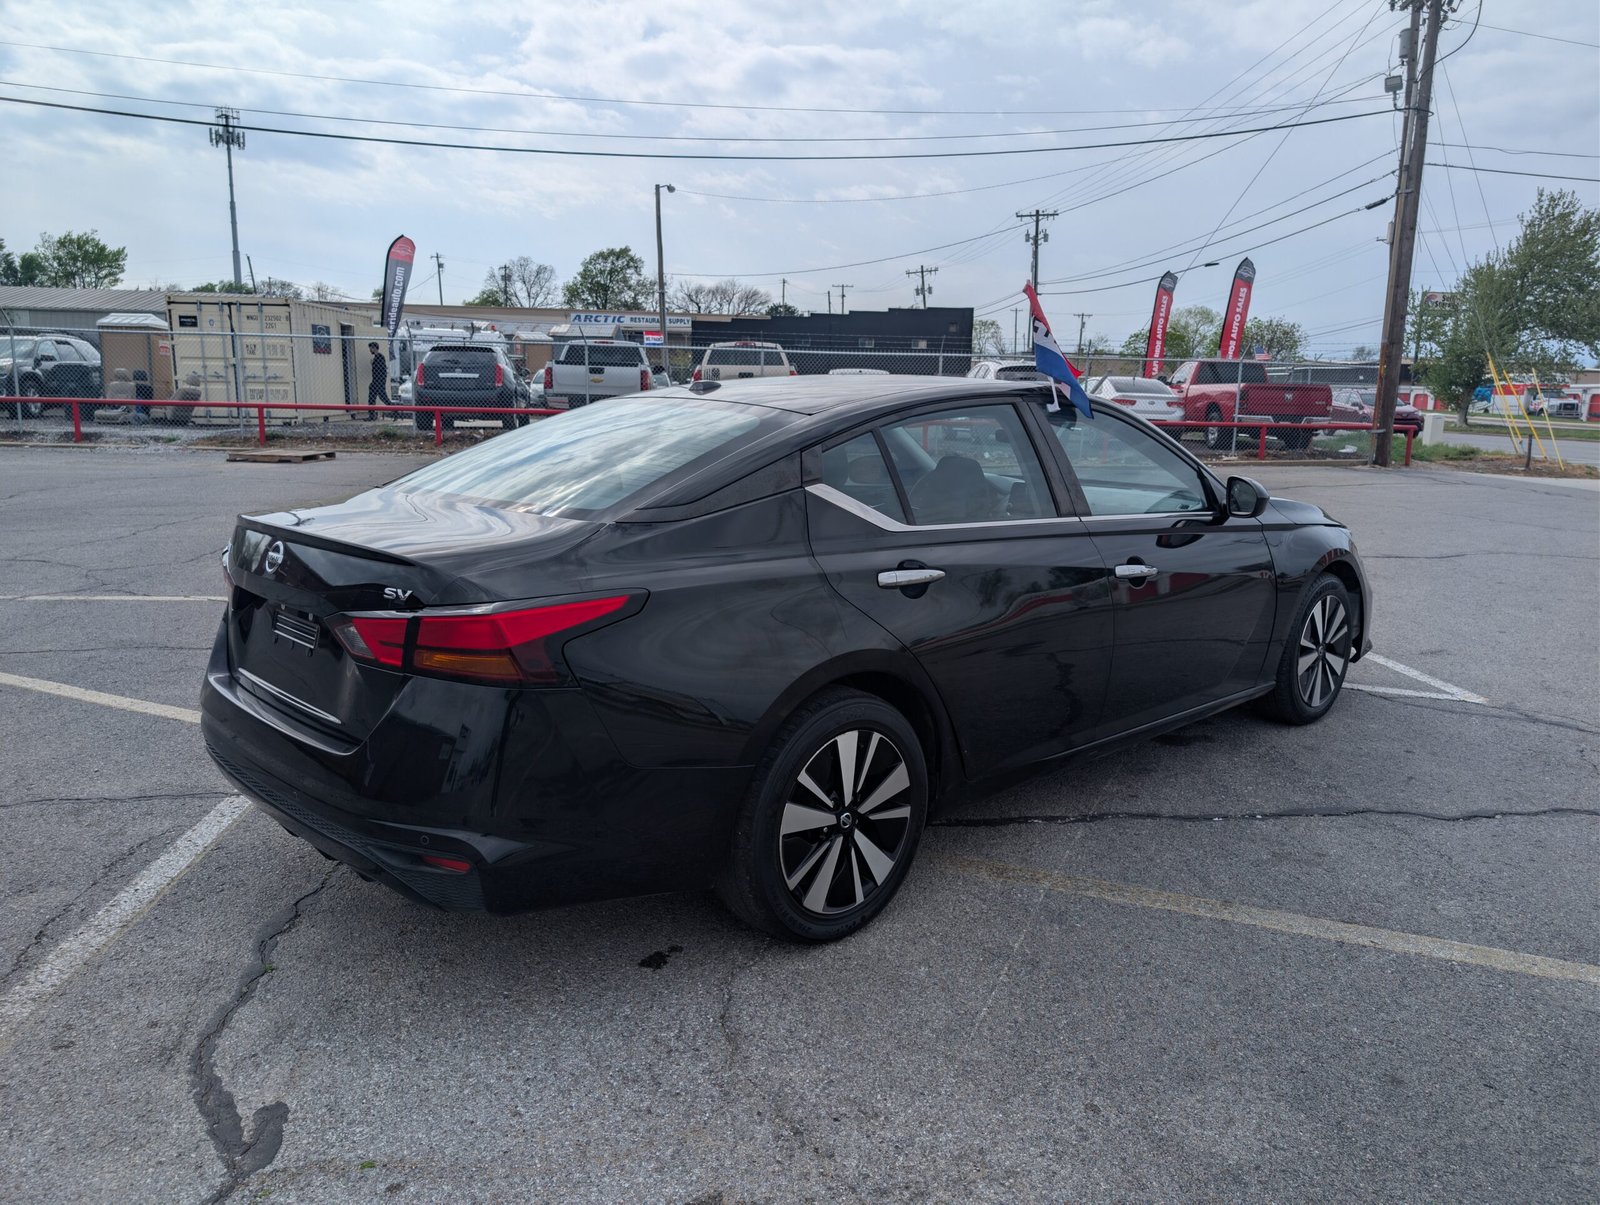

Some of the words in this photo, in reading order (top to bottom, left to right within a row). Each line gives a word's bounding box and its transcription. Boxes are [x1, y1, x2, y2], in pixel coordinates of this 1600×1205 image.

[1159, 296, 1168, 316] SALES
[1231, 314, 1241, 338] AUTO
[1236, 287, 1247, 312] SALES
[572, 314, 625, 323] ARCTIC
[1156, 318, 1164, 338] AUTO
[383, 587, 413, 601] SV
